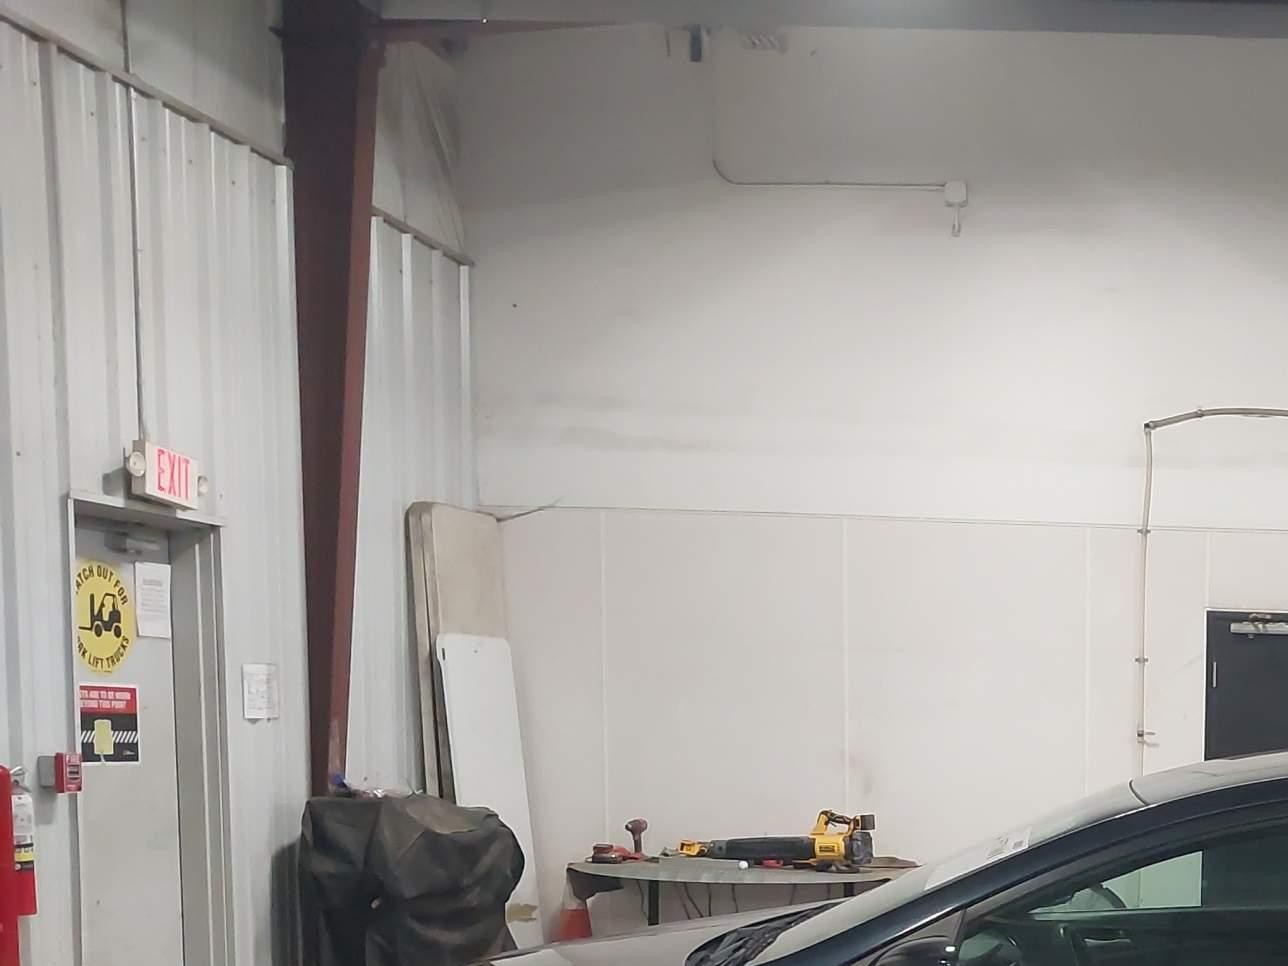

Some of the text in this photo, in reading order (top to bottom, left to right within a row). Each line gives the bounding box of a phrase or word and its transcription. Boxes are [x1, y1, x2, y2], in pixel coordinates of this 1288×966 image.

[157, 448, 191, 500] EXIT
[75, 565, 95, 595] ATCH
[96, 564, 114, 582] OUT
[113, 579, 129, 606] FOR
[88, 653, 105, 669] LIFT
[106, 635, 130, 668] TRUCKS
